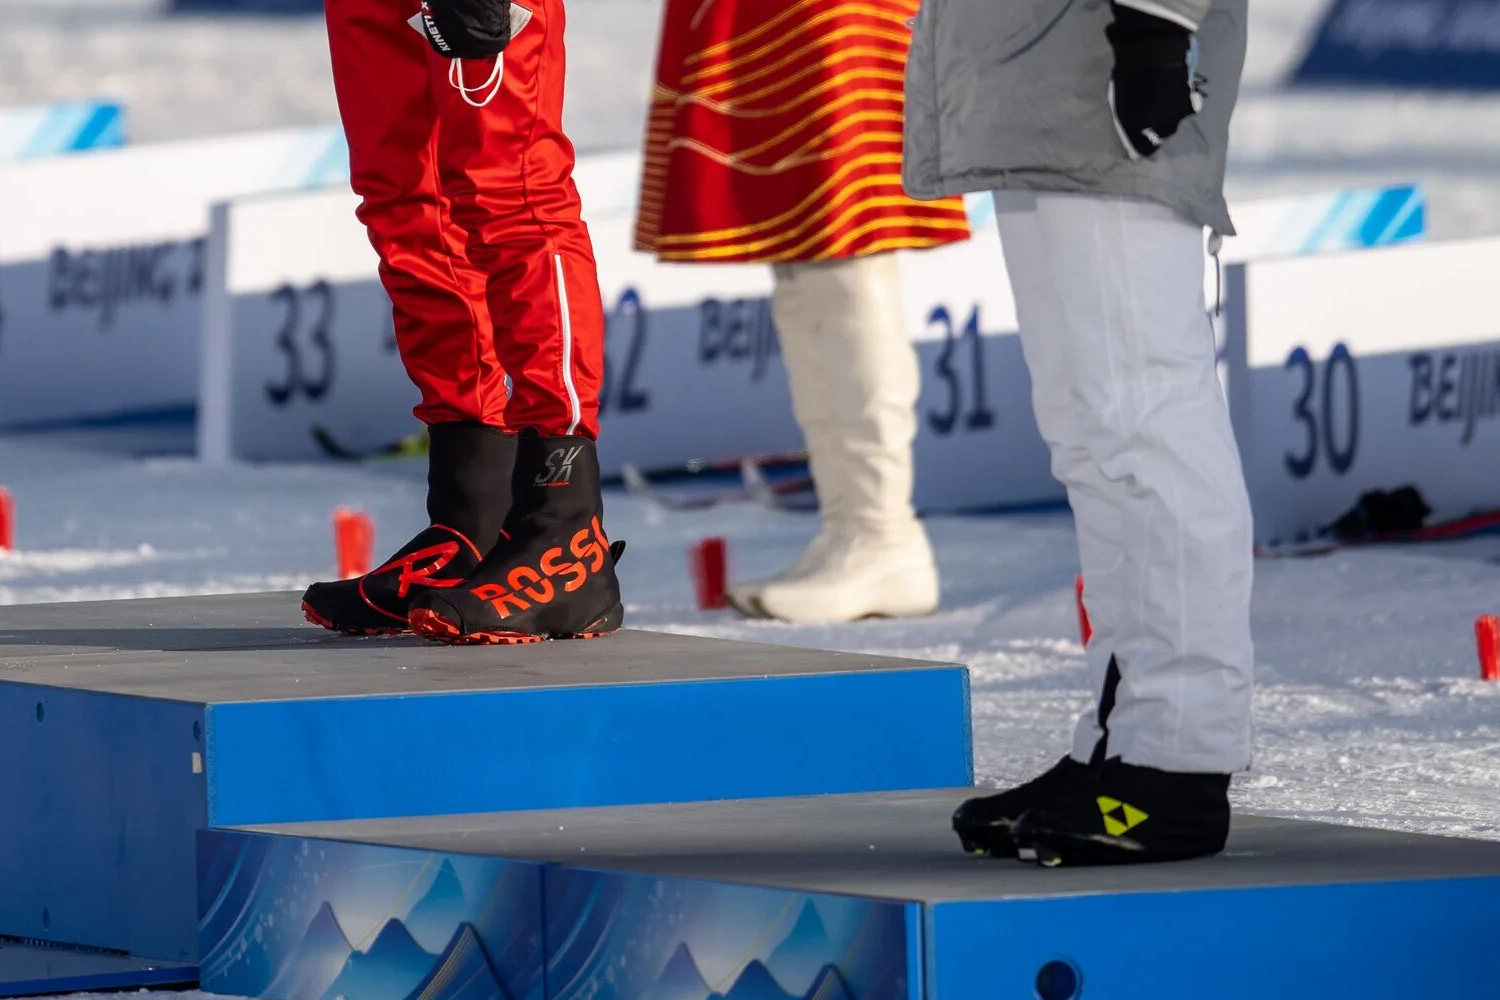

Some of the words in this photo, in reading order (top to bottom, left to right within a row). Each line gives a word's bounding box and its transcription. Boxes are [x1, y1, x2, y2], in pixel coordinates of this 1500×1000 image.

[265, 279, 335, 405] 33
[927, 304, 995, 434] 31
[534, 444, 585, 483] SK
[1283, 342, 1360, 480] 30
